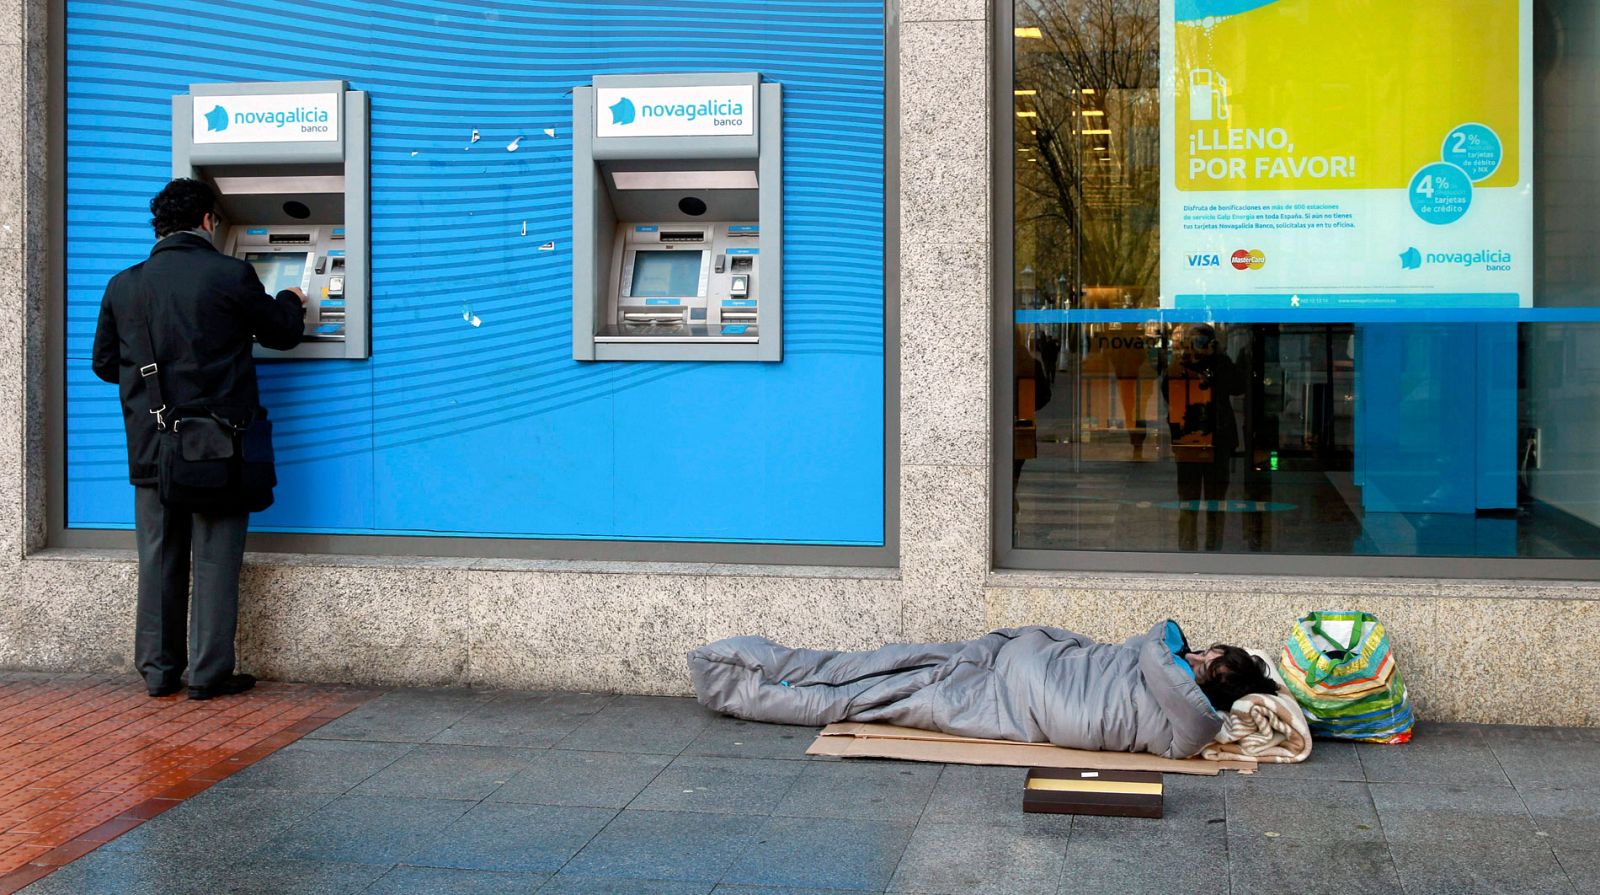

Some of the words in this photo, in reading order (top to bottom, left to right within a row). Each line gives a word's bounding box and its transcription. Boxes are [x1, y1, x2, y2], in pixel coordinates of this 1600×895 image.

[641, 99, 743, 121] novagalicia
[234, 107, 328, 128] novagalicia
[713, 118, 743, 126] banco
[300, 125, 328, 133] banco
[1189, 127, 1295, 156] ¡LLENO,
[1189, 157, 1246, 180] POR
[1255, 155, 1356, 179] FAVOR!
[1434, 196, 1466, 204] tarjetas
[1421, 205, 1432, 213] de
[1433, 204, 1463, 213] crédito
[1219, 222, 1254, 230] Novagalicia
[1187, 254, 1220, 266] VISA
[1426, 249, 1511, 267] novagalicia
